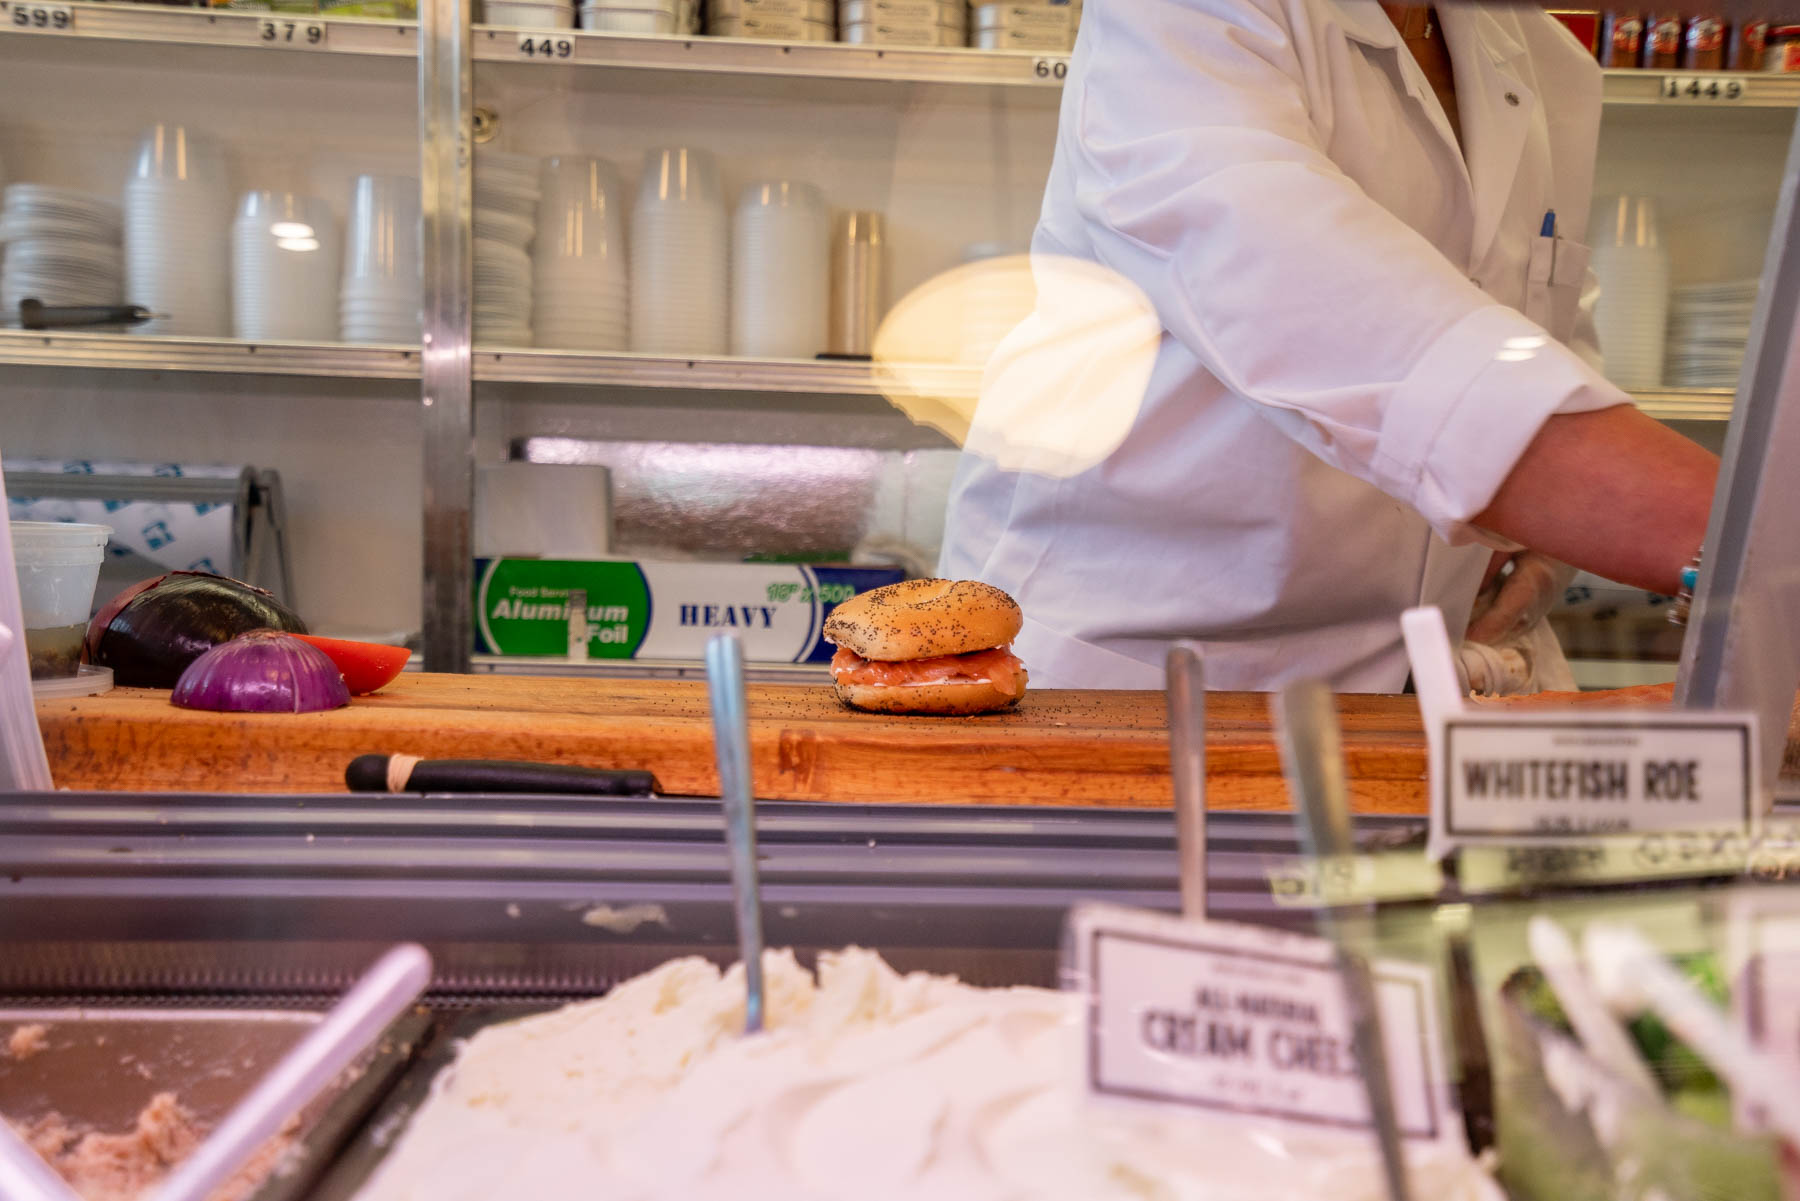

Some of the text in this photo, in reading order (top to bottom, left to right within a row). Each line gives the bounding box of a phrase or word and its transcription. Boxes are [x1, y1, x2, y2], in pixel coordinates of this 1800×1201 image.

[13, 6, 69, 29] 599
[262, 22, 322, 44] 379
[520, 38, 571, 58] 449
[1035, 60, 1068, 79] 60
[1666, 80, 1742, 99] 1449
[509, 586, 538, 598] Food
[491, 598, 629, 622] Alumium
[680, 603, 776, 629] HEAVY
[586, 624, 629, 643] Foil
[1462, 758, 1699, 801] WHITEFISH ROE
[1140, 1008, 1255, 1060] CREAM
